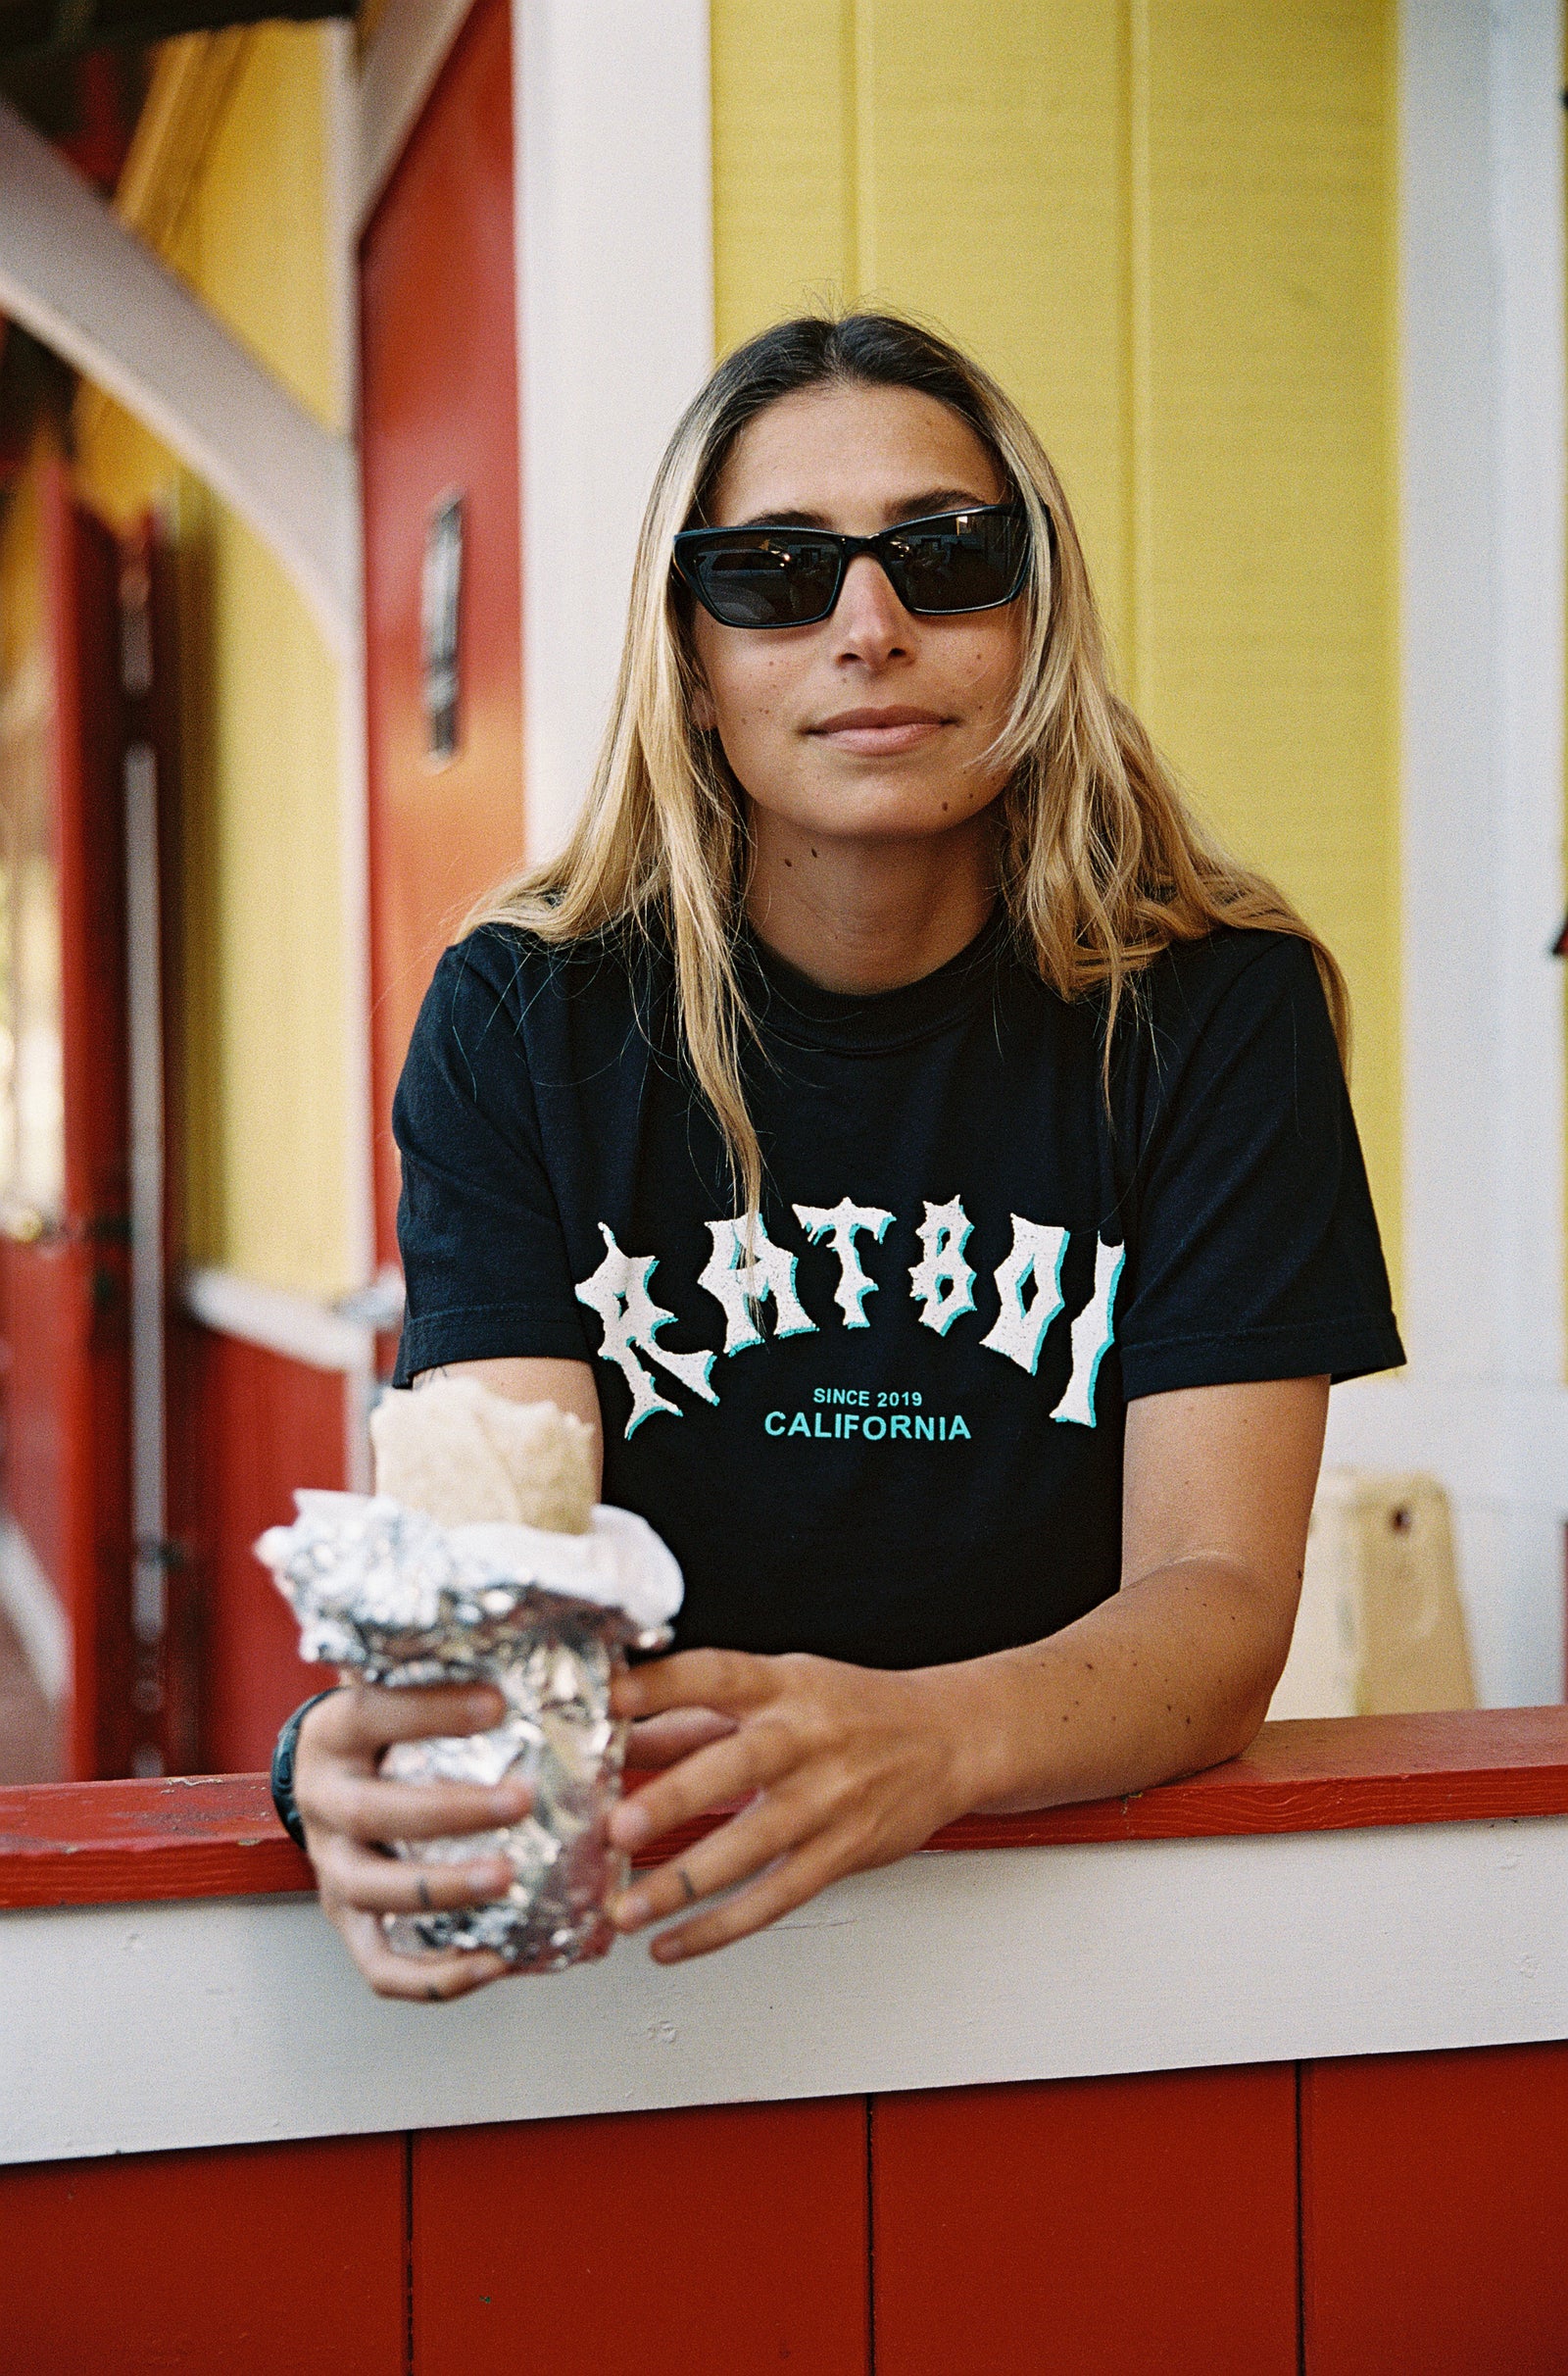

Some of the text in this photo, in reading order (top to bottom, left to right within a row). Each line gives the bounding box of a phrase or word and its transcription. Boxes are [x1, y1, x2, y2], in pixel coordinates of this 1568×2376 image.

[813, 1388, 923, 1408] SINCE 2019
[764, 1411, 971, 1441] CALIFORNIA
